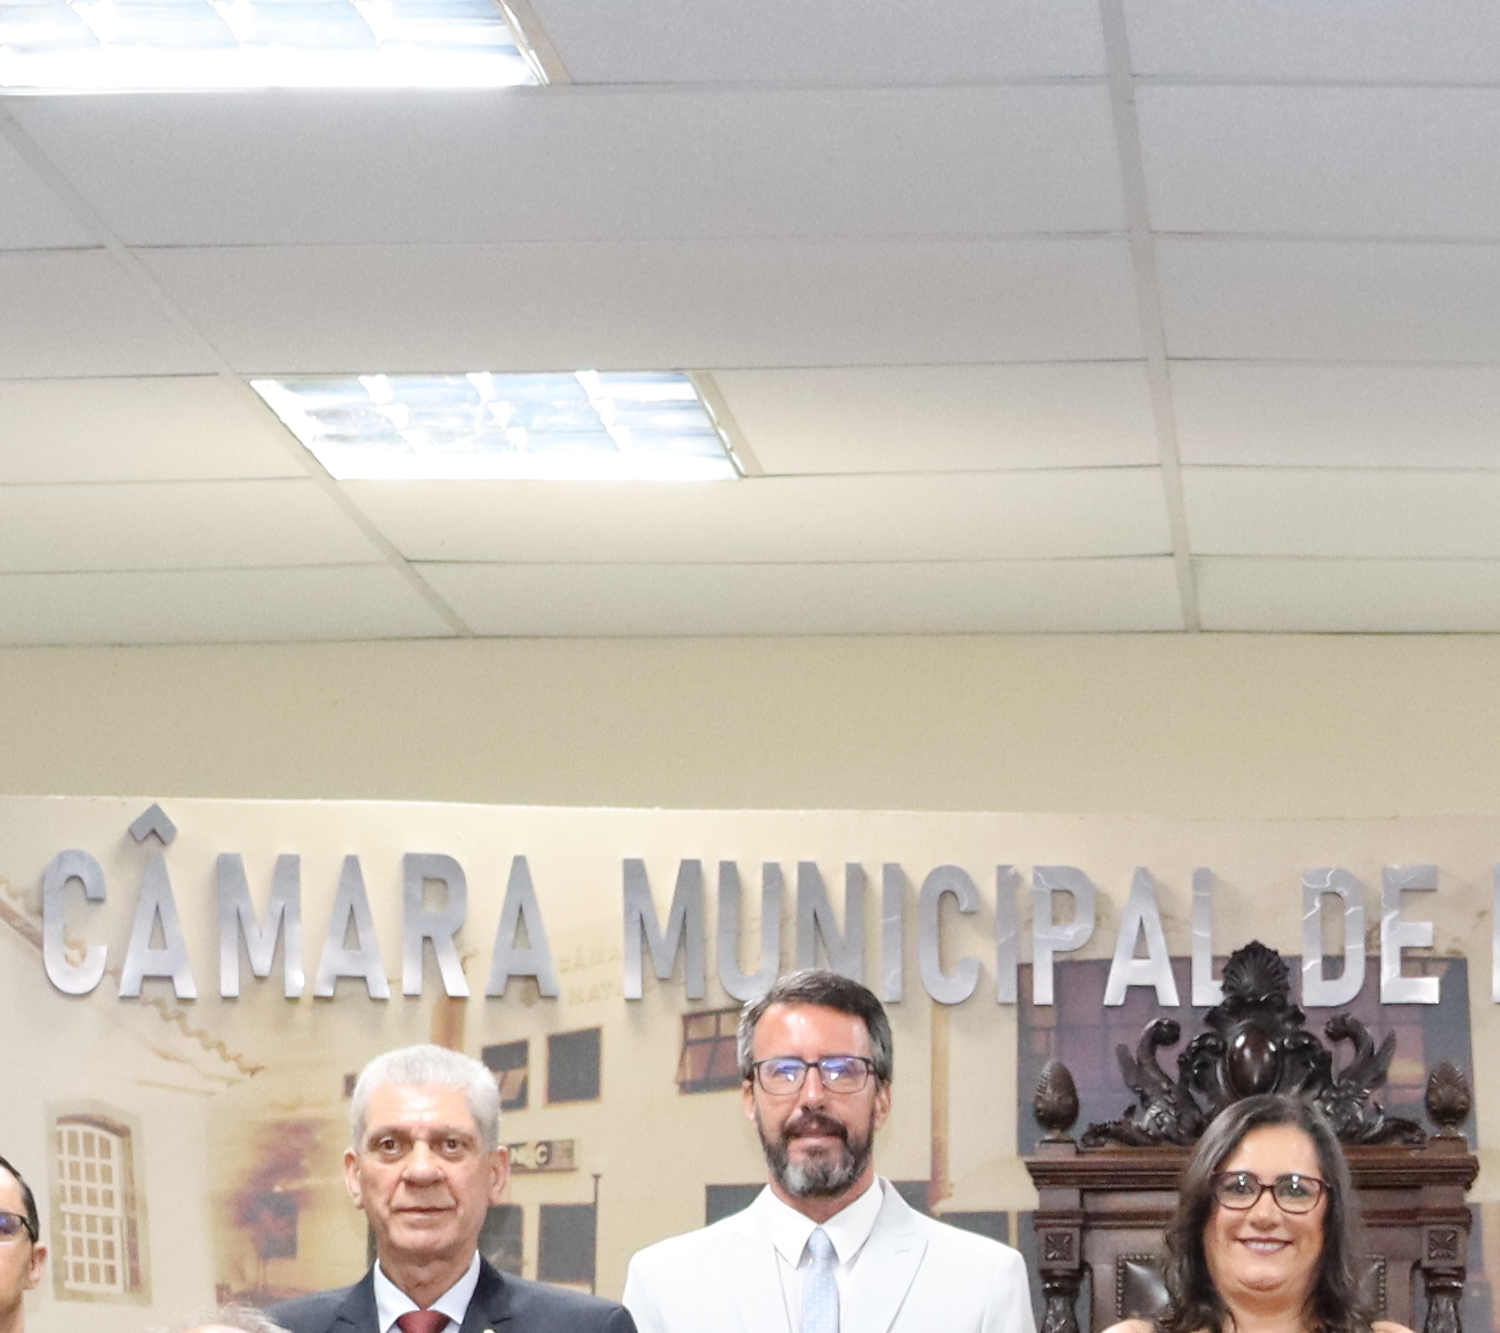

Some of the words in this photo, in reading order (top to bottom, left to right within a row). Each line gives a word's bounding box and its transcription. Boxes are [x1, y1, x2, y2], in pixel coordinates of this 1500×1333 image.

[41, 802, 560, 1000] CÂMARA
[622, 857, 1224, 1008] MUNICIPAL
[1301, 864, 1440, 1008] DE
